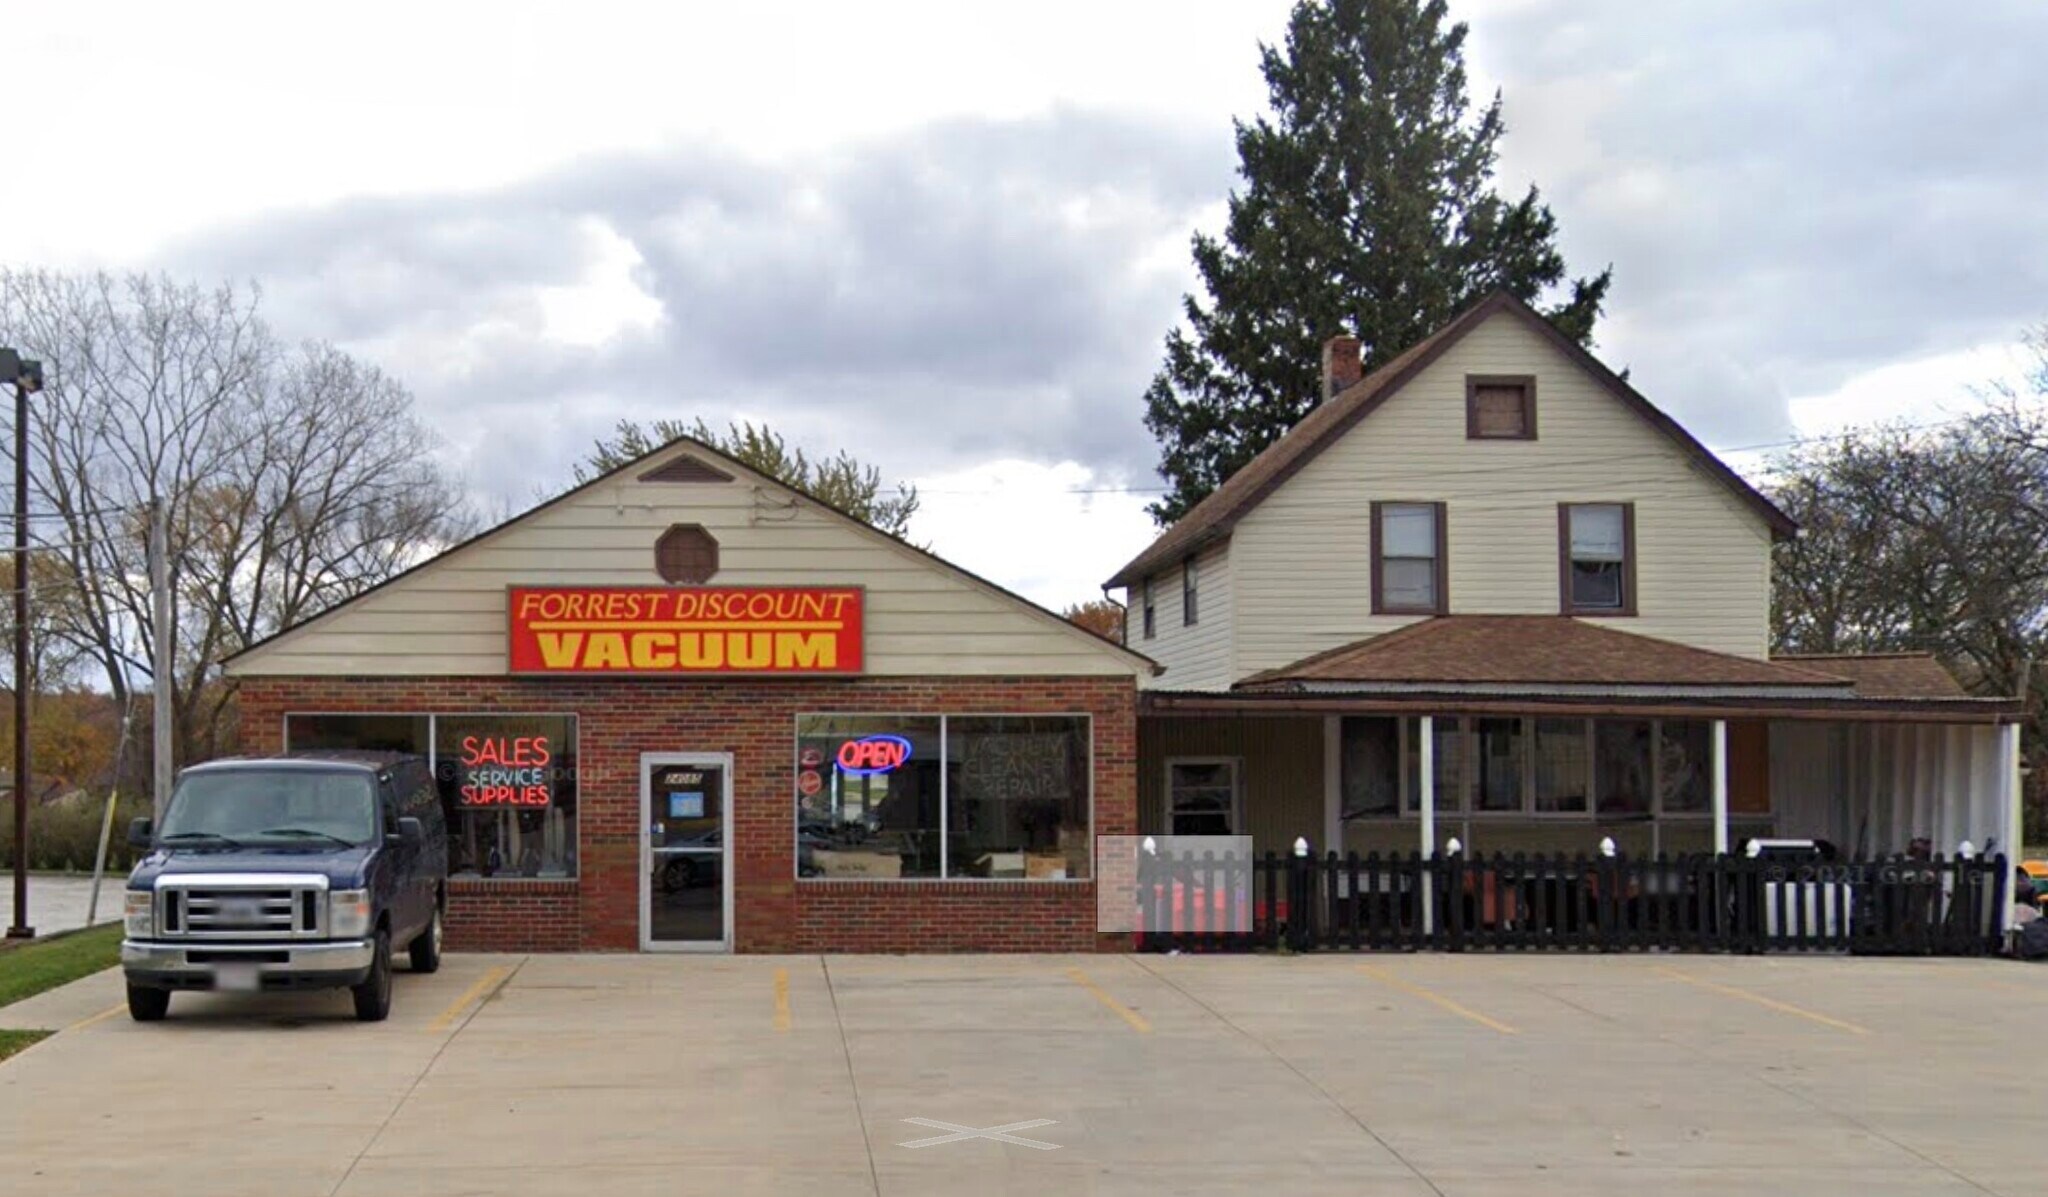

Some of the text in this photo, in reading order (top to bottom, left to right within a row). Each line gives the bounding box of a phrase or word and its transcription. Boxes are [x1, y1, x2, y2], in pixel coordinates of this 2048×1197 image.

[519, 592, 855, 620] FORREST DISCOUNT
[536, 632, 838, 668] VACUUM
[460, 736, 550, 766] SALES
[838, 740, 904, 767] OPEN
[468, 768, 543, 789] SERVICE
[460, 785, 550, 805] SUPPLIES
